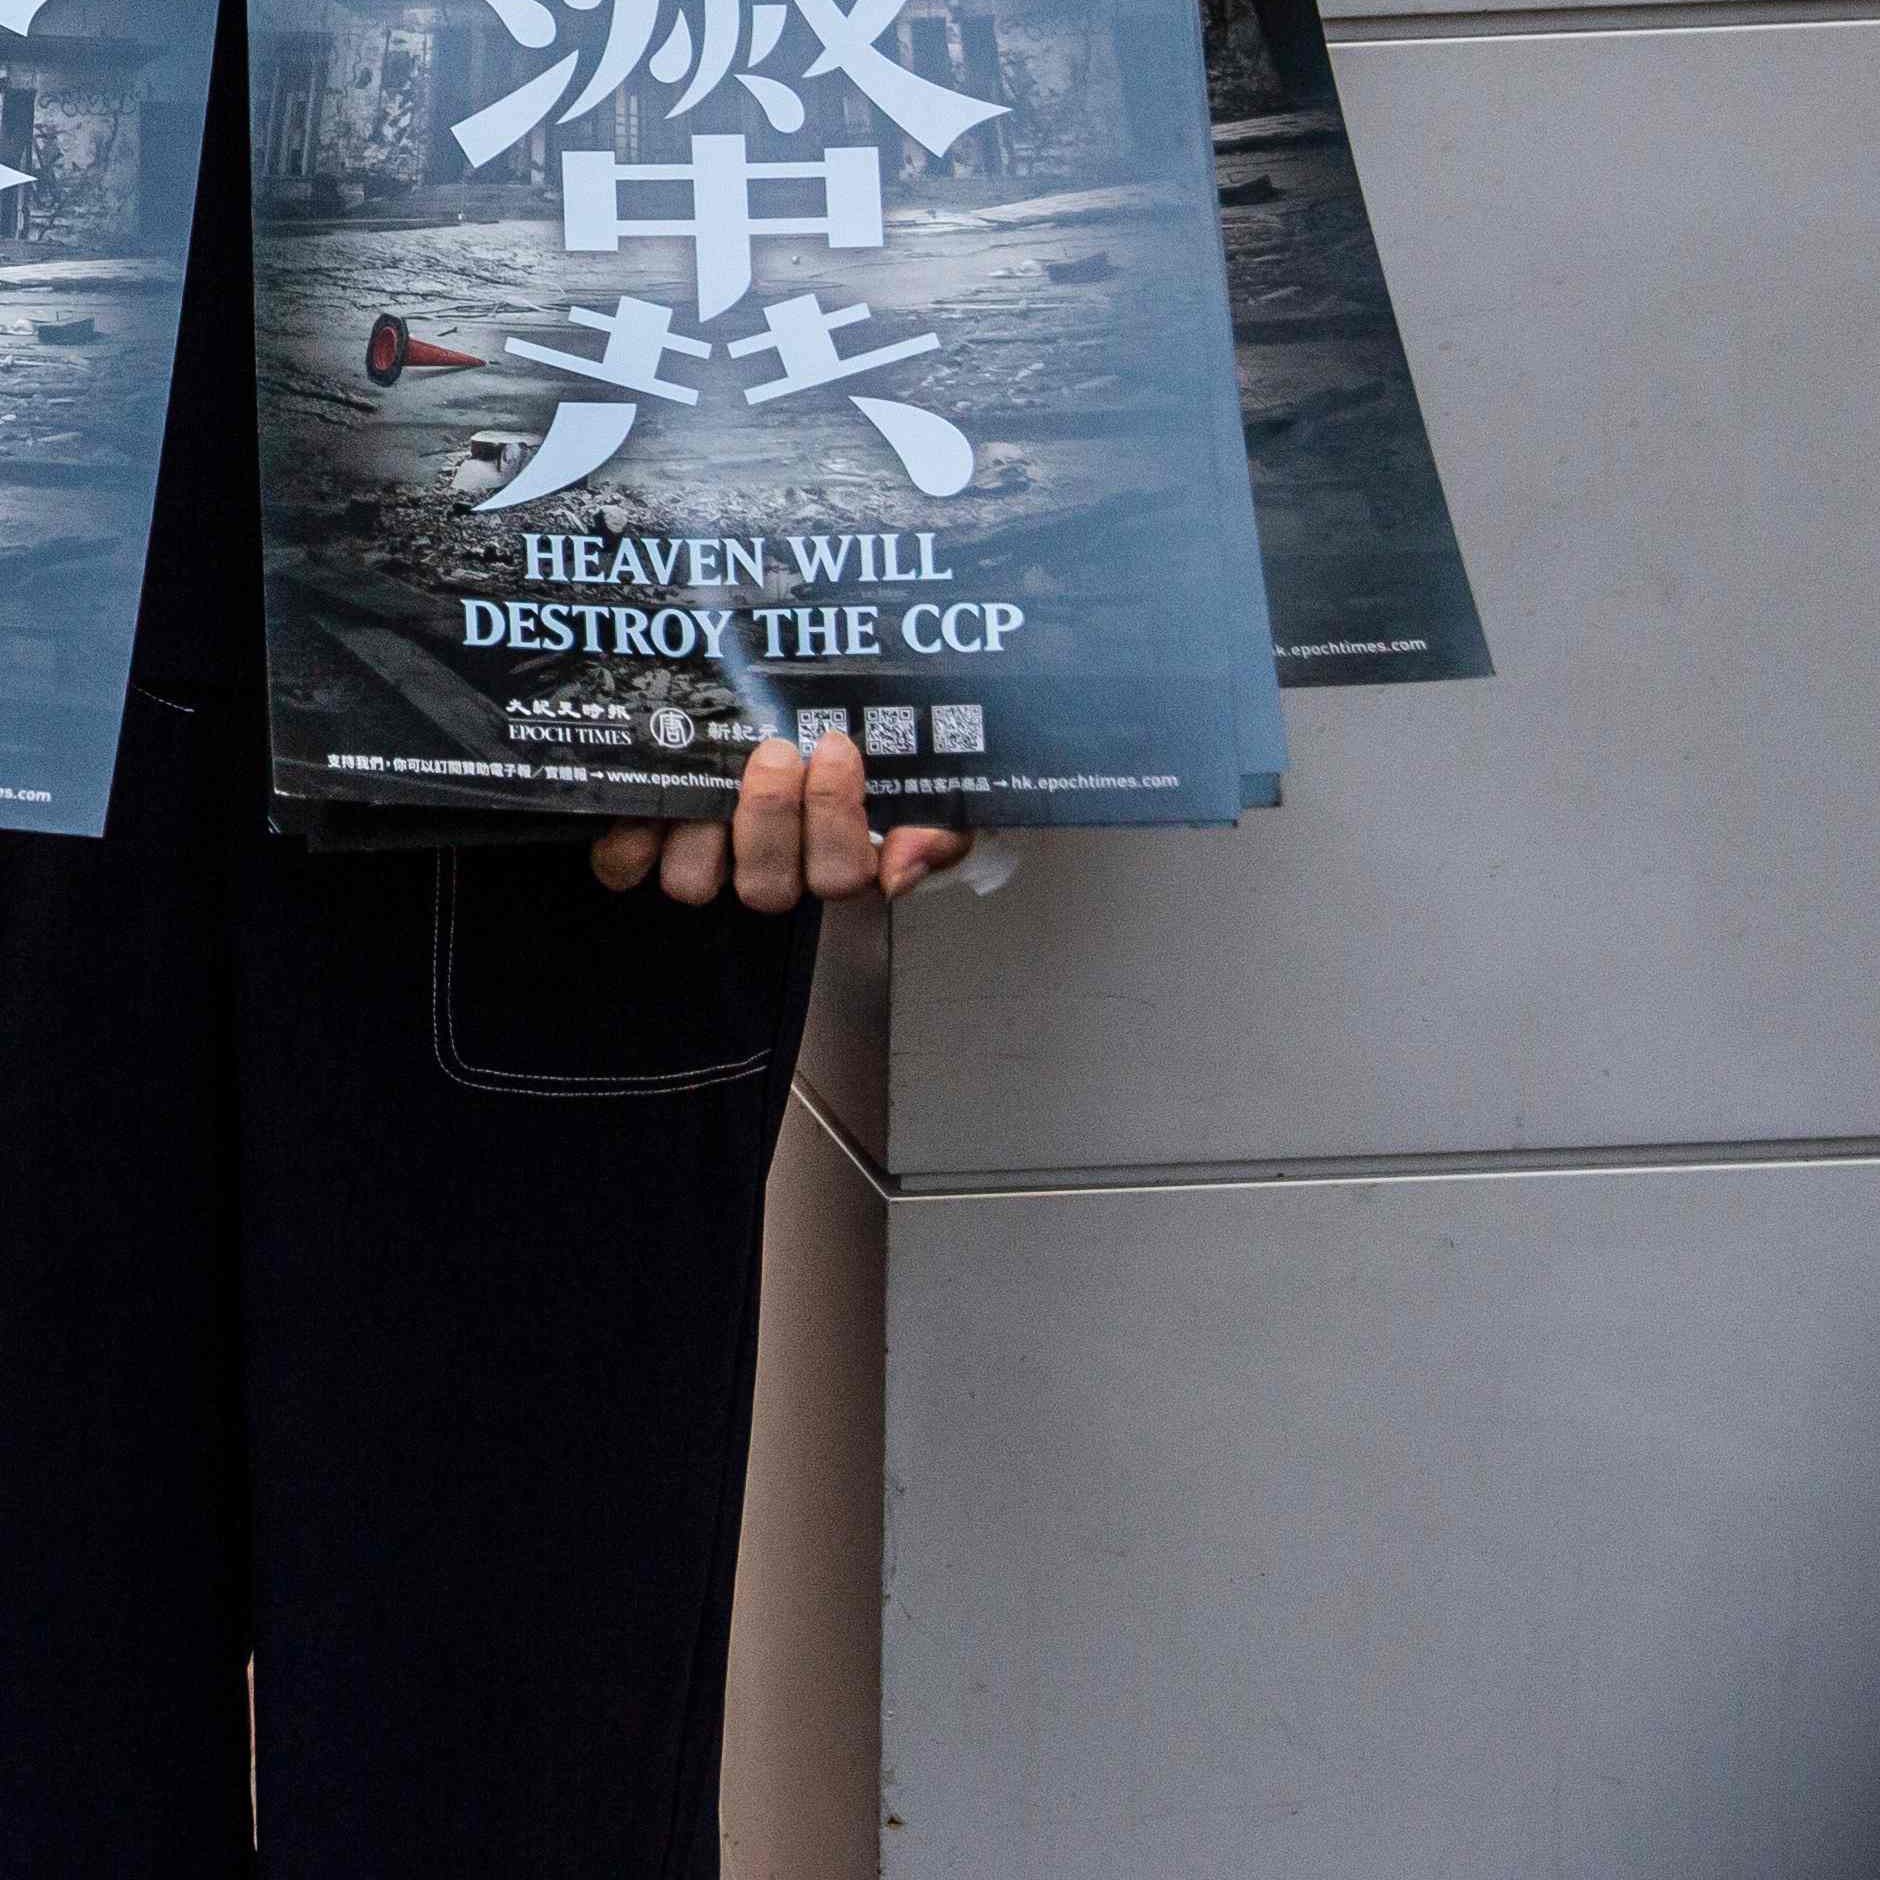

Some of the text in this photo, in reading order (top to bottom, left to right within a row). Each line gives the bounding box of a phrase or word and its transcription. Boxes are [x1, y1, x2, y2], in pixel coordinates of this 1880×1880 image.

[523, 532, 953, 588] HEAVEN WILL
[460, 598, 1024, 660] DESTROY THE CCP
[508, 724, 632, 745] EPOCH TIMES
[606, 770, 742, 790] www.epochtimes
[1011, 774, 1180, 793] hk.epochtimes.com
